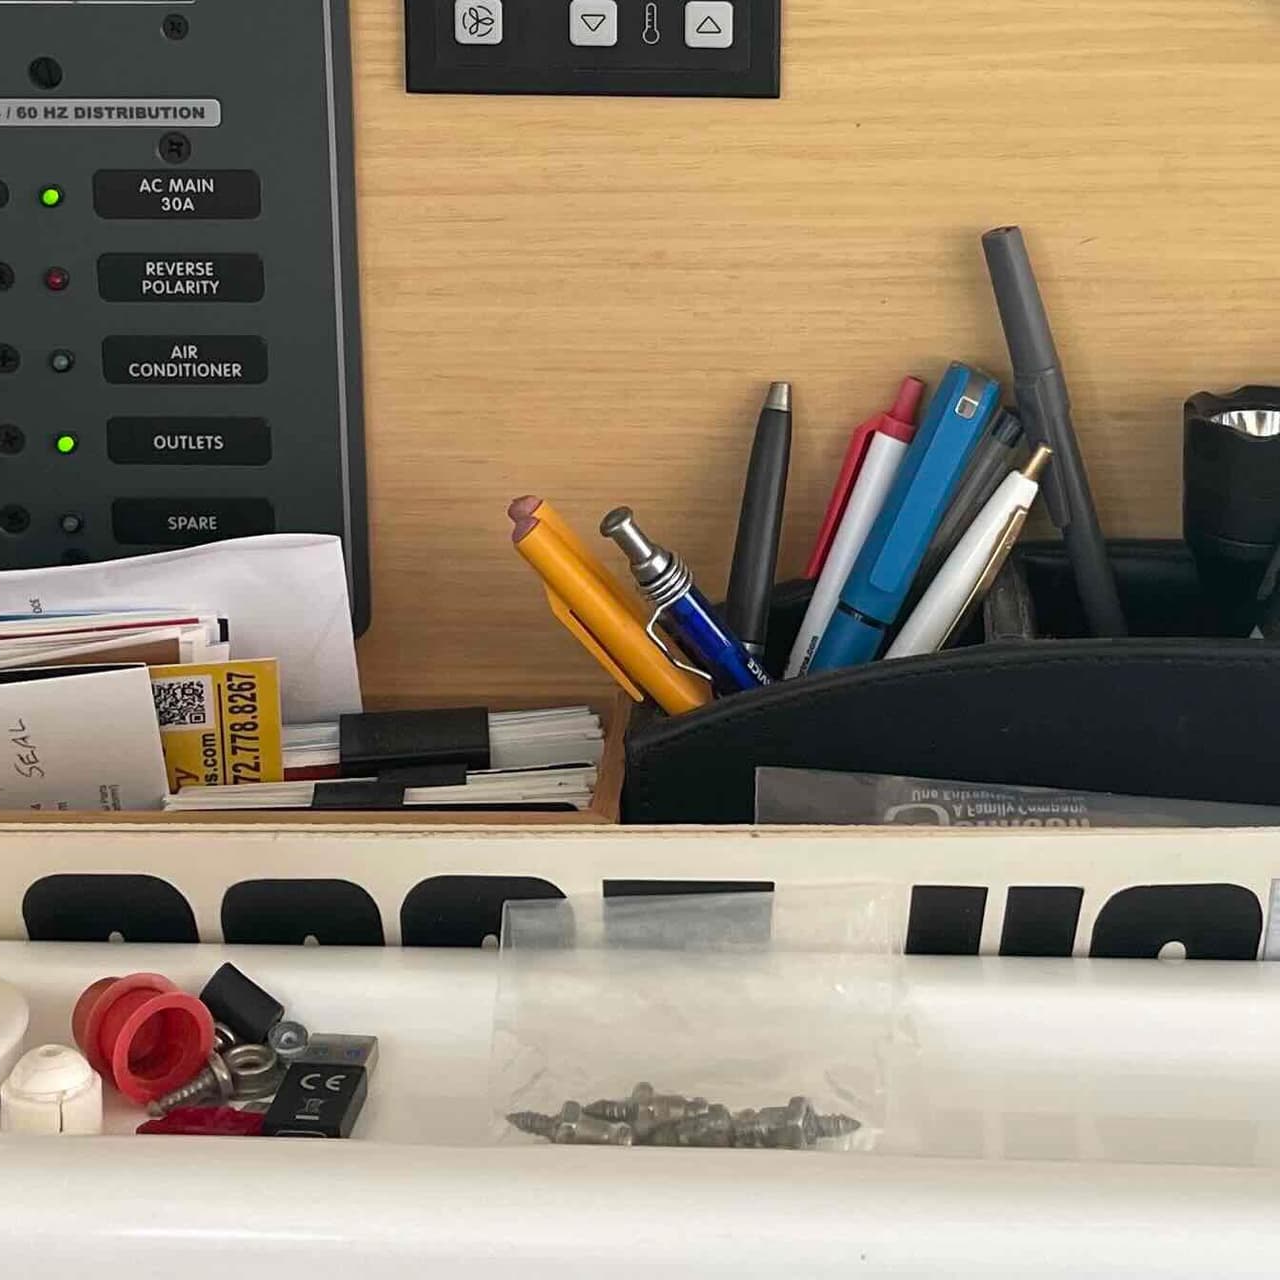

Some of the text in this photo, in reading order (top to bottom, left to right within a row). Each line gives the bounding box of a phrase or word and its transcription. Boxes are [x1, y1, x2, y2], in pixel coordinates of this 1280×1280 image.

[15, 106, 38, 119] 60
[43, 106, 68, 119] HZ
[74, 106, 206, 119] DISTRIBUTION
[139, 179, 214, 193] AC MAIN
[161, 197, 195, 211] 30A
[146, 262, 214, 276] REVERSE
[142, 280, 220, 294] POLARITY
[171, 345, 198, 359] AIR
[128, 363, 242, 377] CONDITIONER
[153, 436, 224, 450] OUTLETS
[167, 516, 217, 531] SPARE
[226, 672, 261, 785] 72.778.8267
[8, 718, 45, 779] SEAL
[202, 733, 218, 786] s.com
